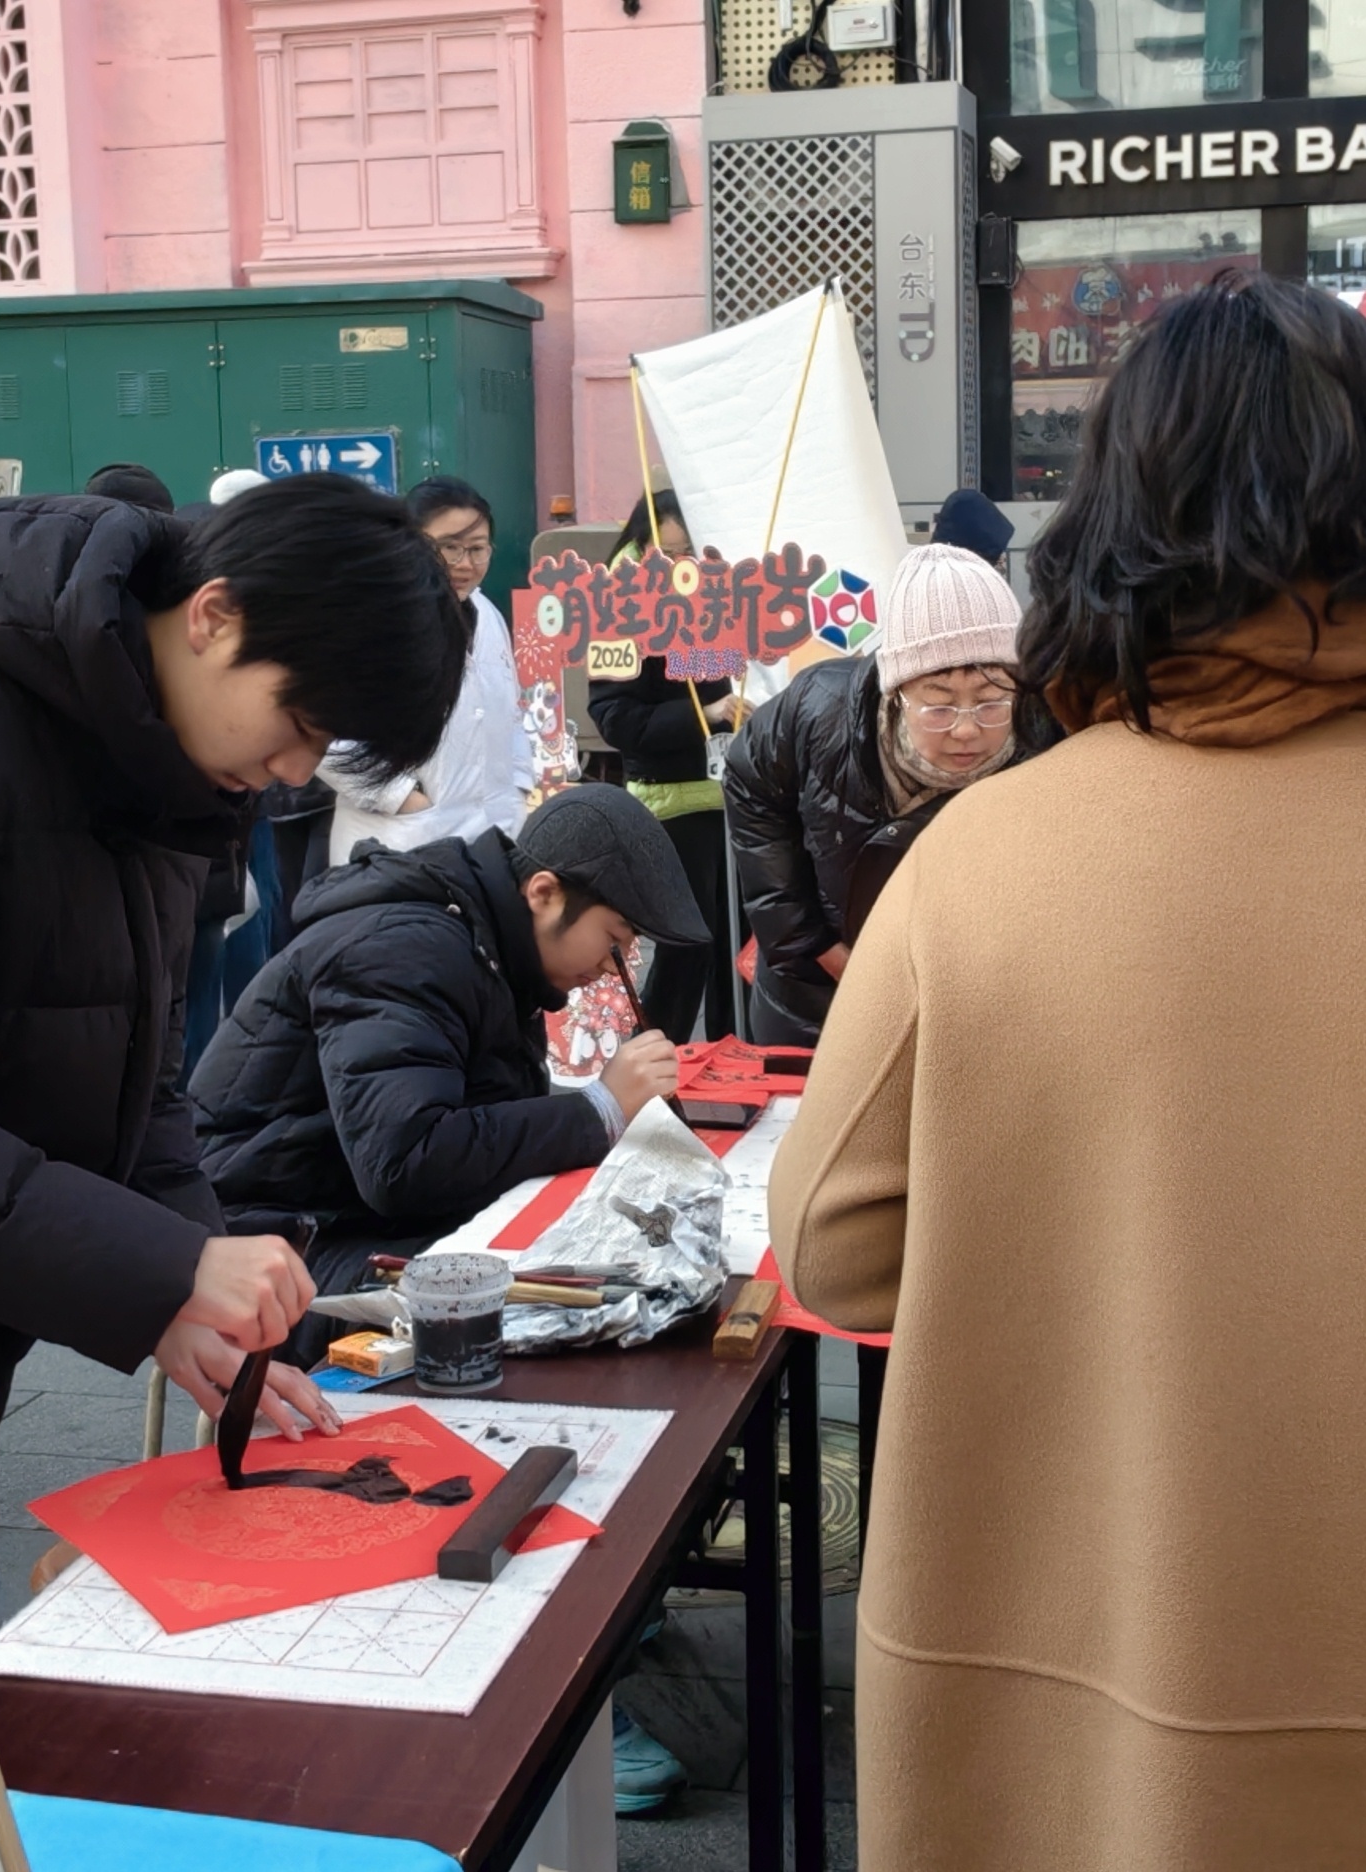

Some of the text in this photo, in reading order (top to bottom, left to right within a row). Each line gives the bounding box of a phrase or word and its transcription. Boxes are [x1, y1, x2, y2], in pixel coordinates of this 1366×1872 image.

[1048, 128, 1280, 187] RICHER
[898, 232, 925, 301] 台东
[529, 541, 827, 664] 萌娃贺新岁
[591, 645, 635, 669] 2026
